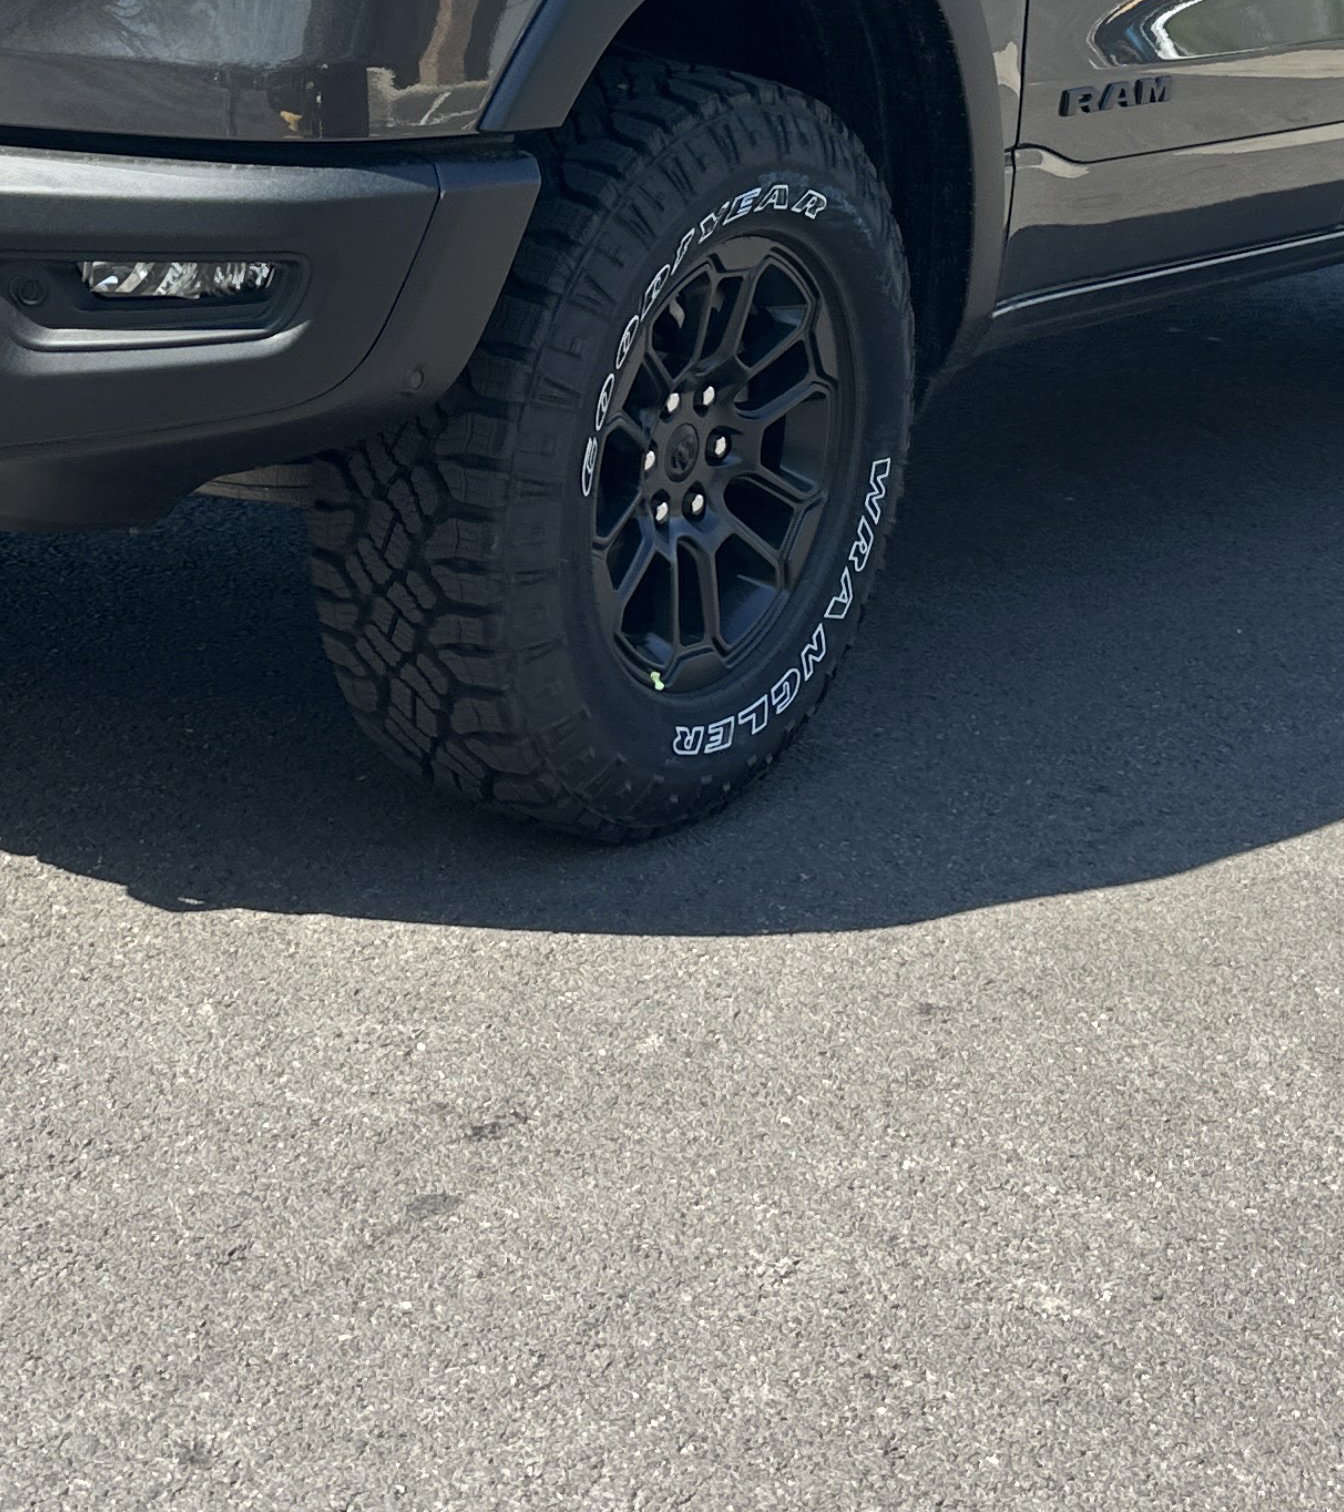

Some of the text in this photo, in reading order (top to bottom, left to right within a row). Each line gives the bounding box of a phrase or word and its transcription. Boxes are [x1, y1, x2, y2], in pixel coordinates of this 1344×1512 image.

[1058, 75, 1173, 117] RAM
[581, 184, 828, 498] GOODYEAR
[672, 457, 891, 757] WRANGLER
